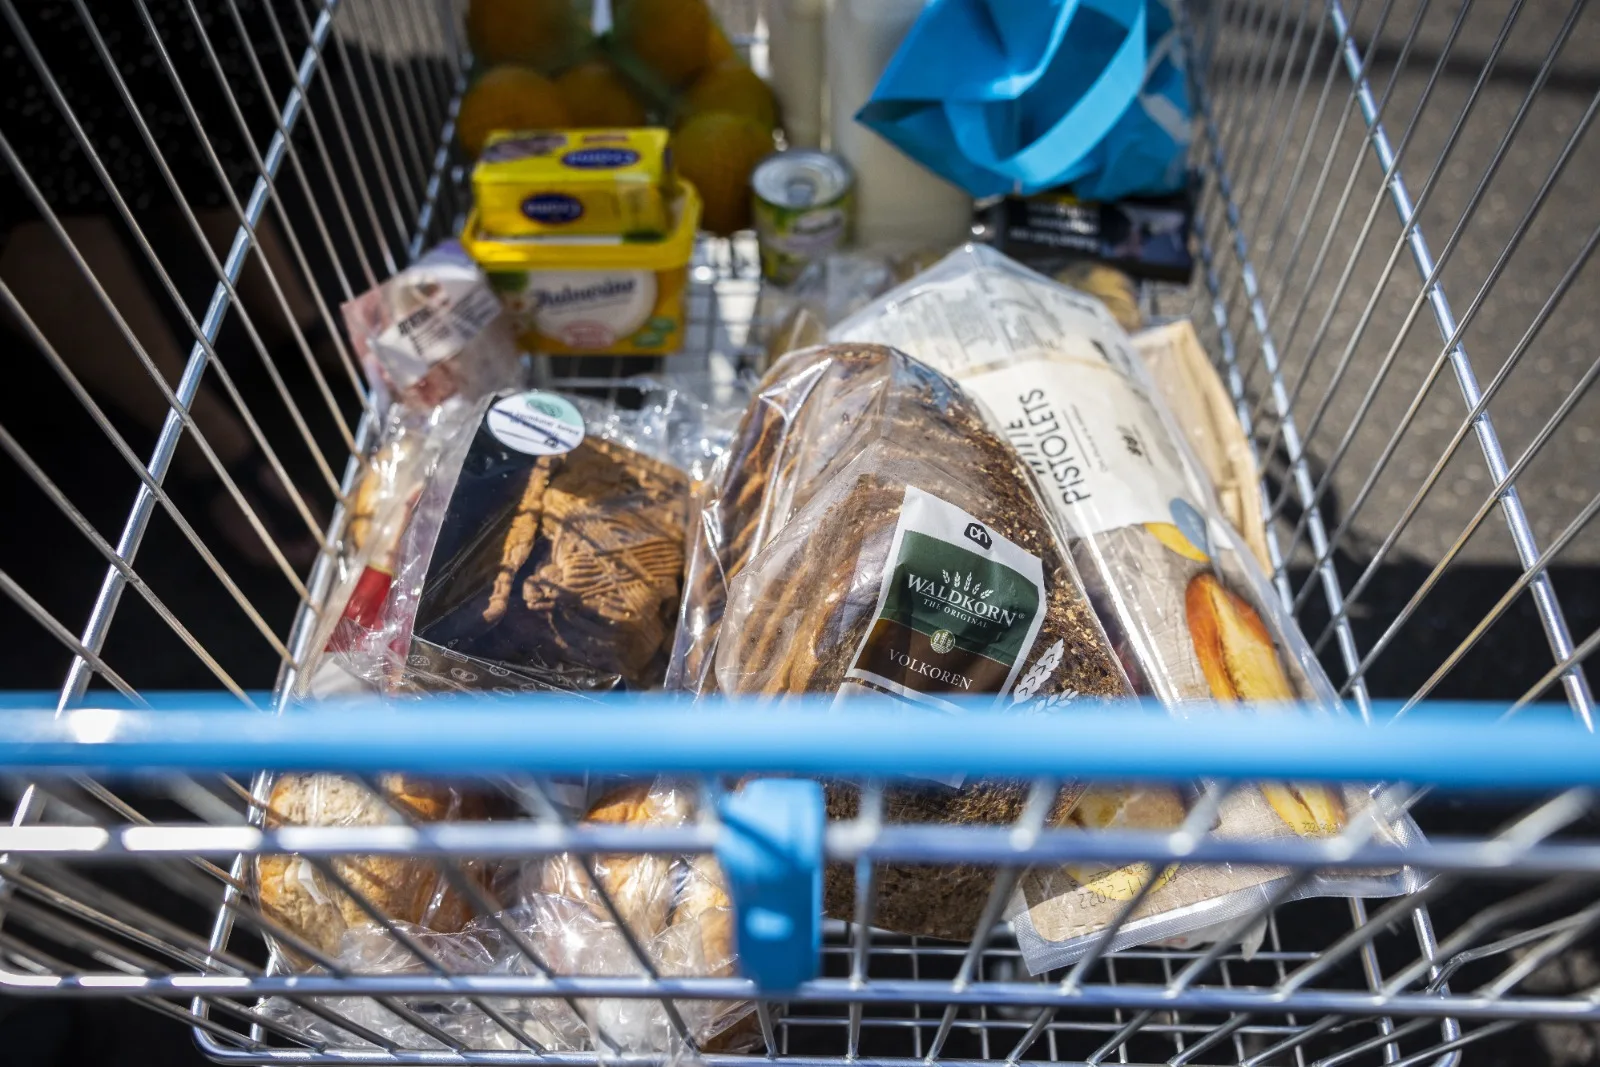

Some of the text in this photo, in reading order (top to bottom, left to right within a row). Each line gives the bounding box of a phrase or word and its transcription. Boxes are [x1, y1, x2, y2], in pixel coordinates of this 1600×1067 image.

[1018, 389, 1092, 505] PISTOLETS
[923, 598, 941, 611] THE
[943, 606, 988, 628] ORIGINAL
[889, 648, 974, 691] VOLKOREN
